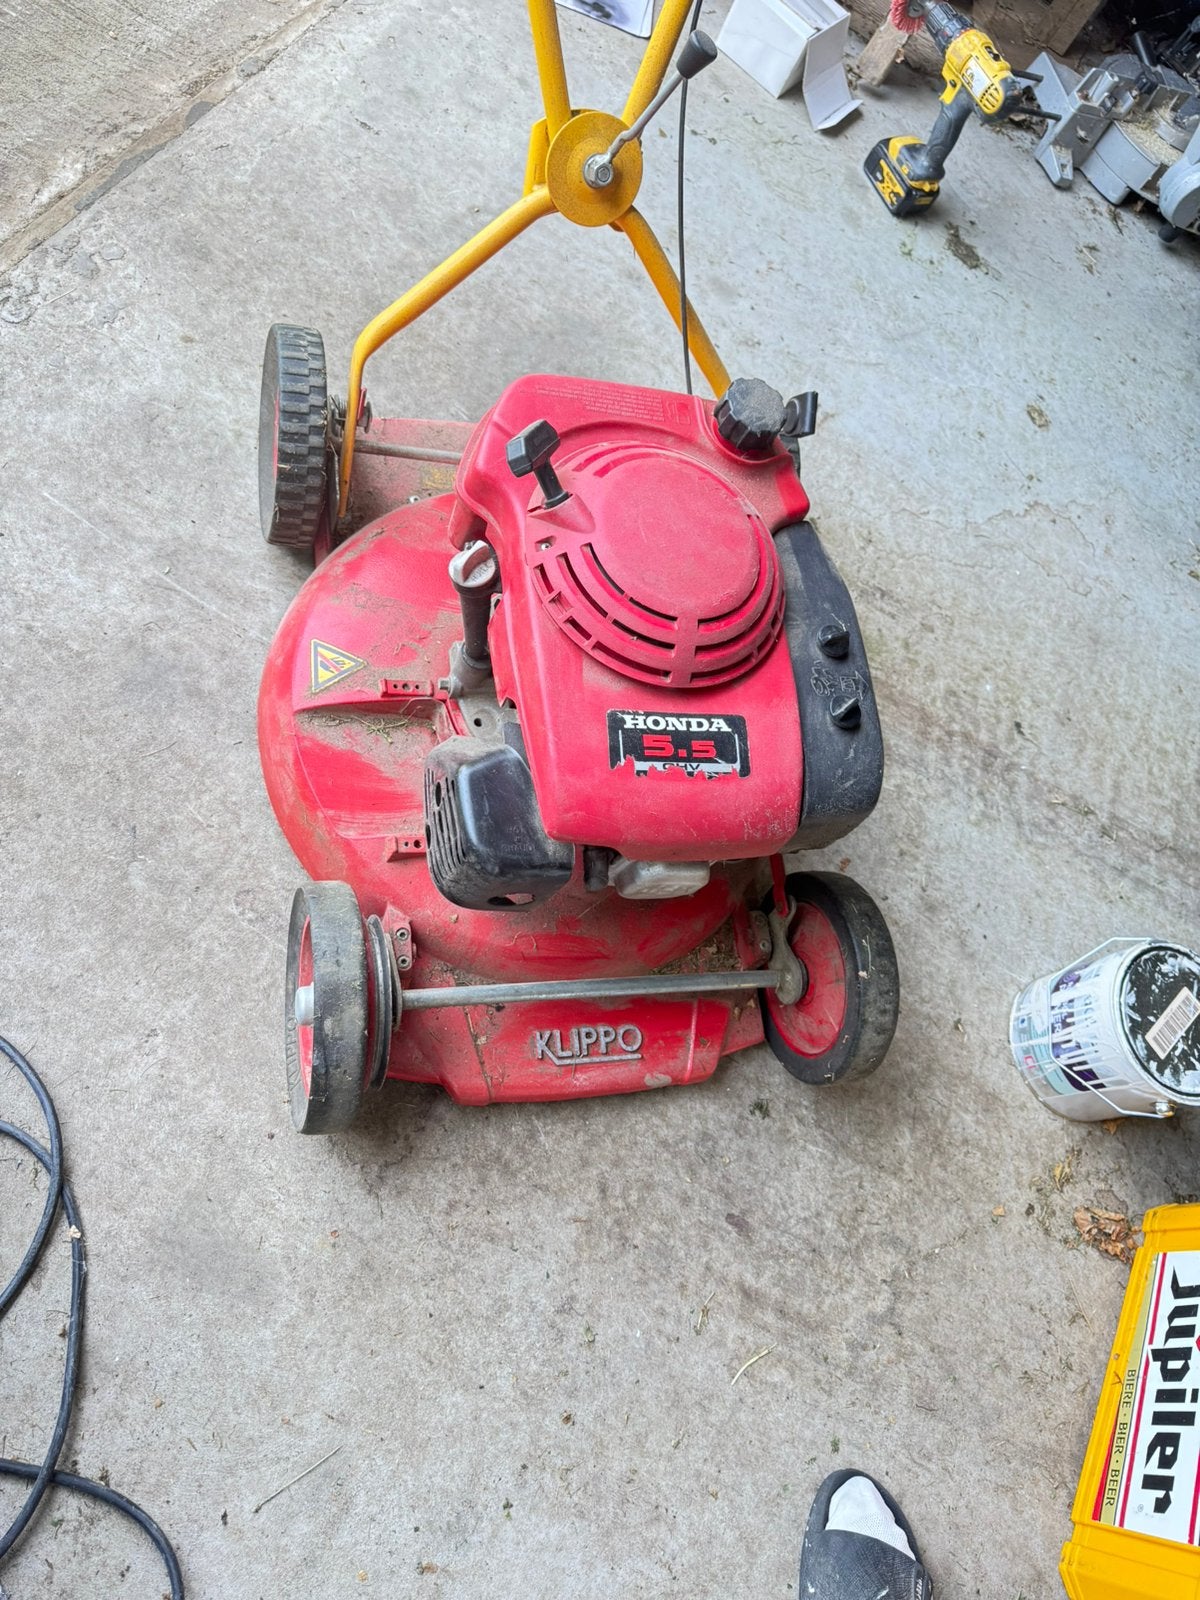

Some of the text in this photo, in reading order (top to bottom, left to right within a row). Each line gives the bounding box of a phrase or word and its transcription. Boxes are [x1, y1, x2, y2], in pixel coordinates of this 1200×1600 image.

[623, 714, 732, 732] HONDA
[642, 733, 717, 758] 5.5
[534, 1024, 643, 1066] KLIPPO
[1141, 1265, 1200, 1514] Jupiler
[1104, 1369, 1136, 1507] BIERE BIER BEER
